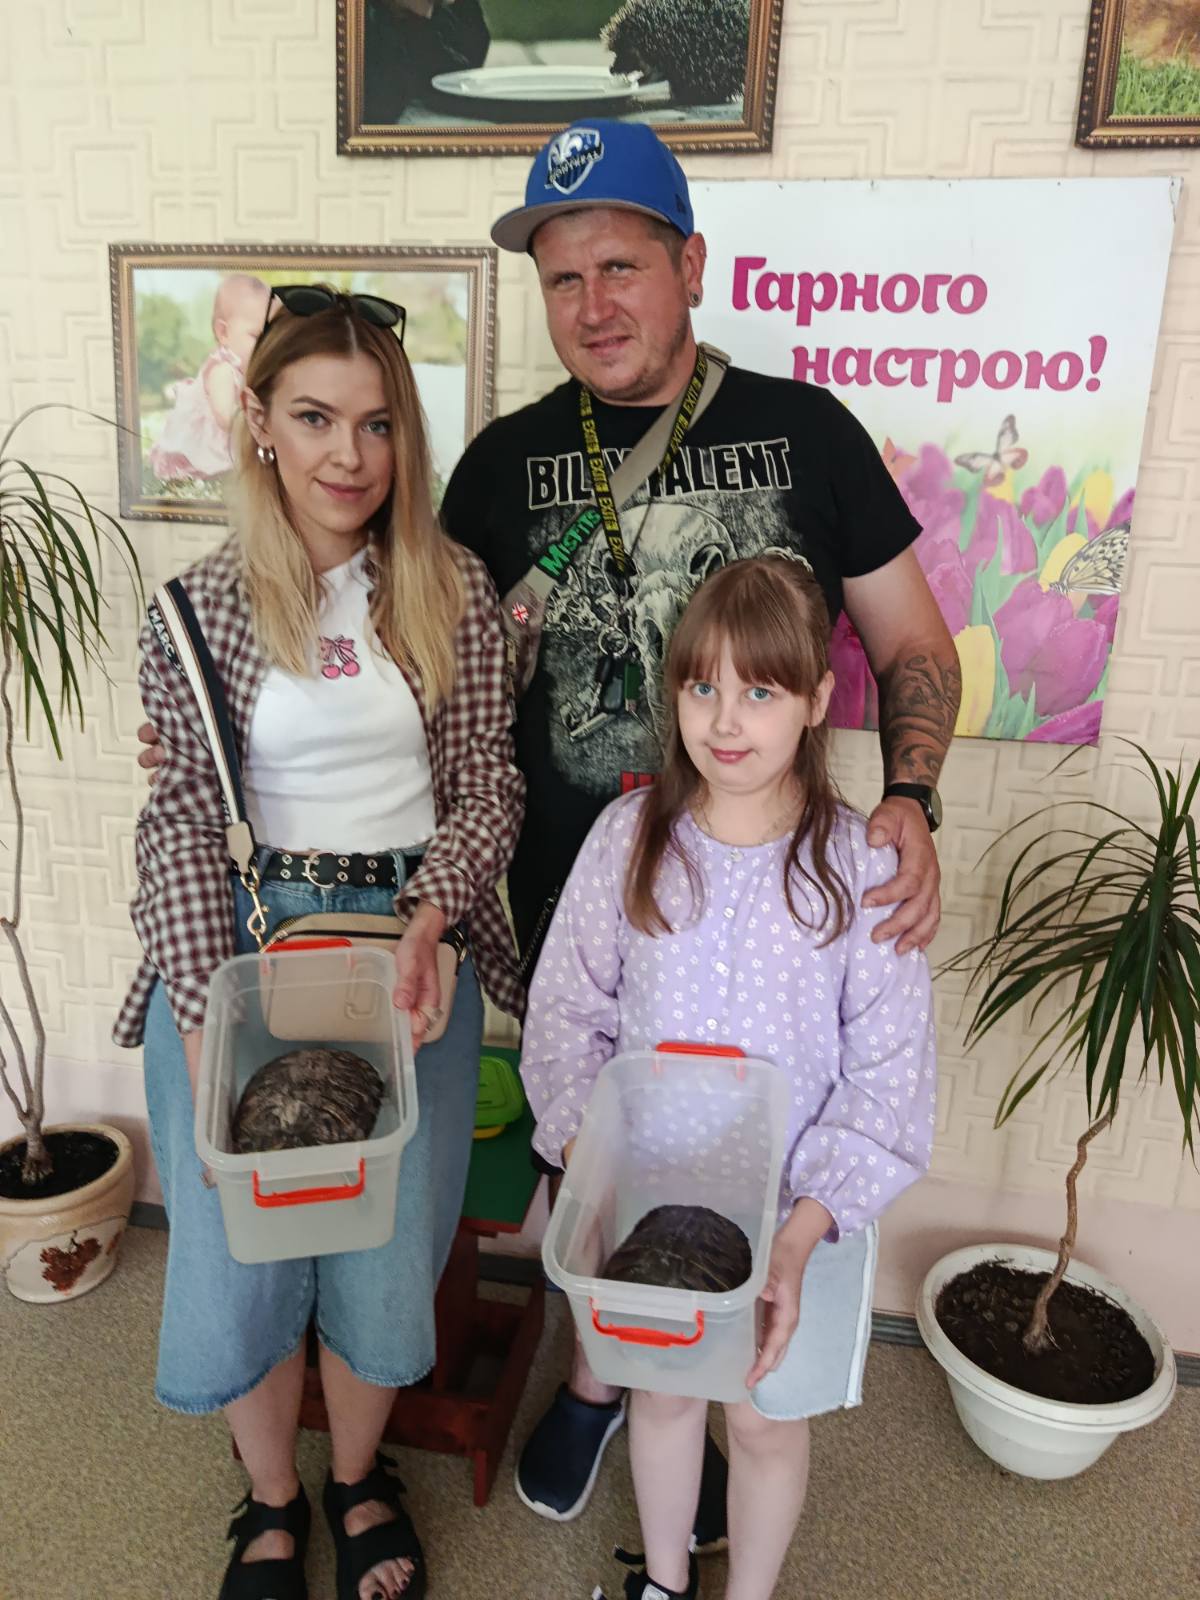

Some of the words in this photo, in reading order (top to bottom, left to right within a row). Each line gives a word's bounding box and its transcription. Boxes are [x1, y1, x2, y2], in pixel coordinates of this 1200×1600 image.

[731, 256, 988, 327] Гарного
[791, 335, 1108, 403] настрою!
[527, 448, 632, 510] BIL
[148, 607, 176, 658] MARC
